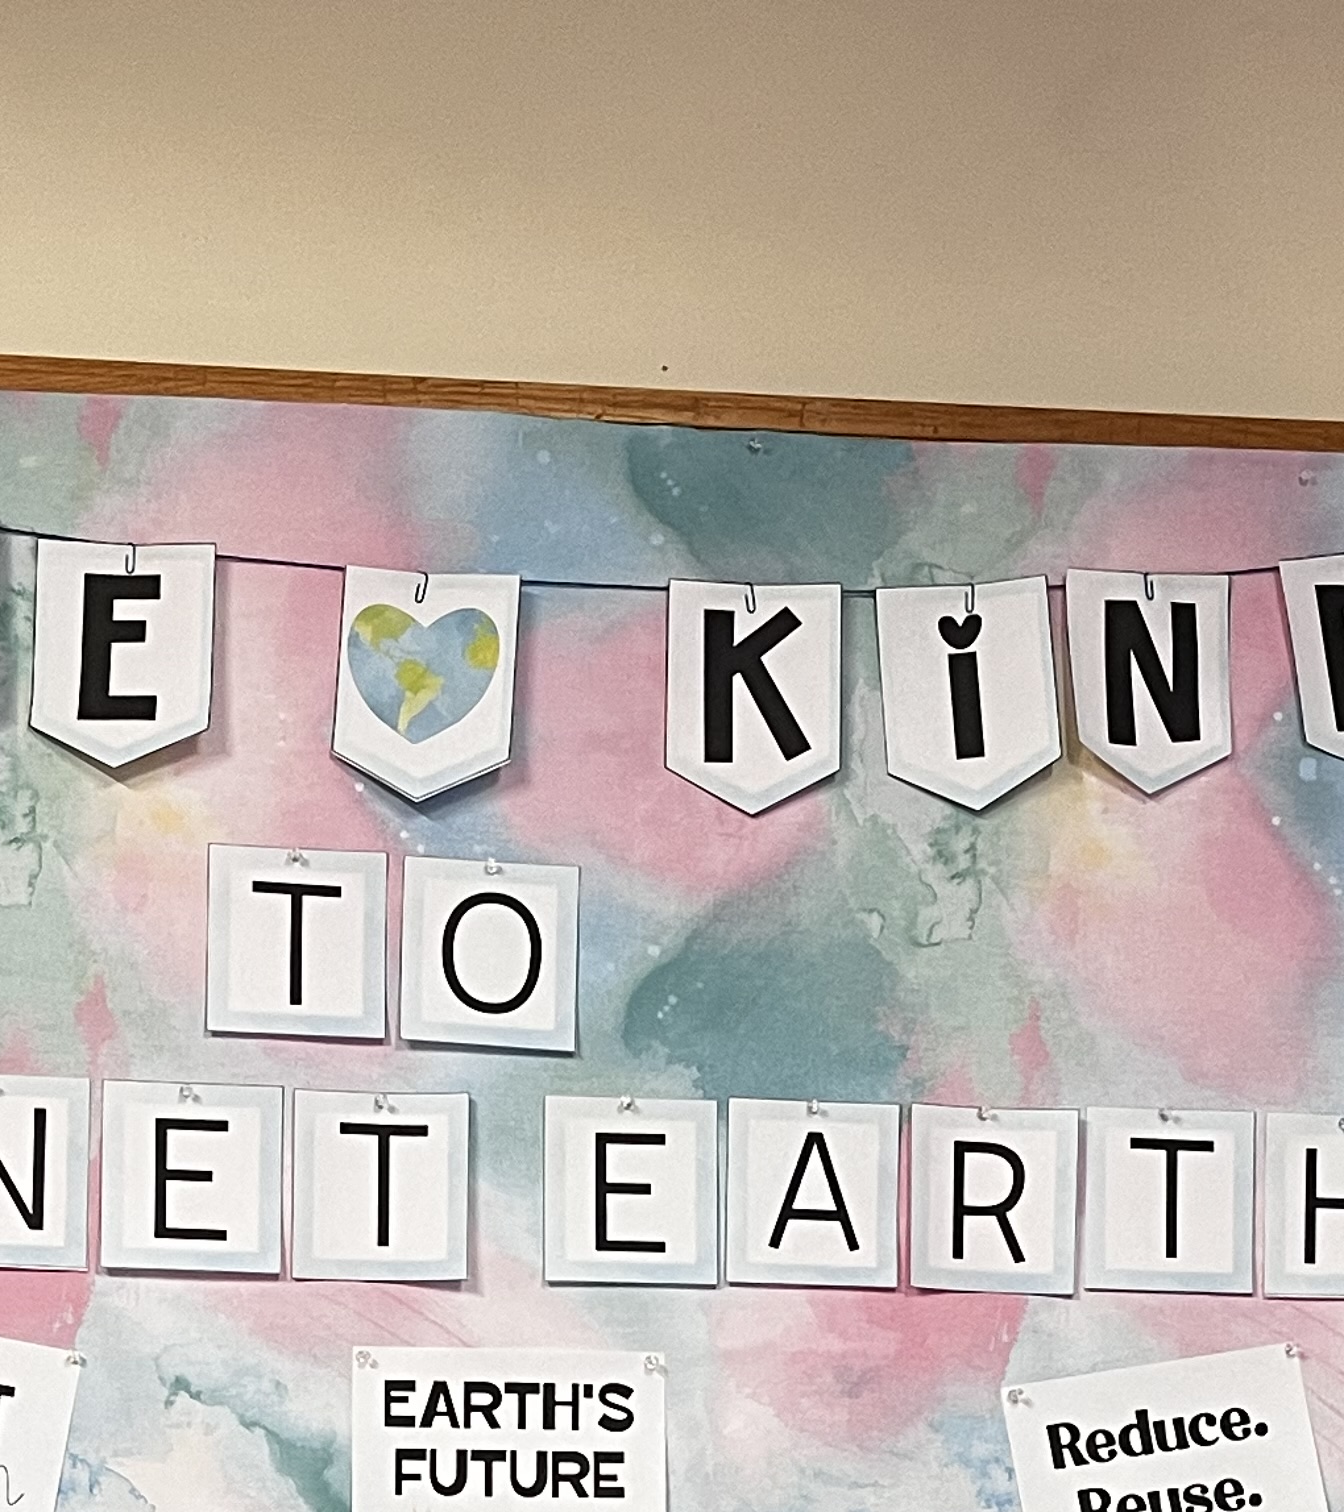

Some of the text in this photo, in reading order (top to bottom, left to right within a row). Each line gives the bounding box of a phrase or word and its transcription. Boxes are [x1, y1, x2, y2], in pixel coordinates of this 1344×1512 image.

[252, 881, 542, 1014] TO
[383, 1379, 635, 1432] EARTH'S
[1045, 1406, 1270, 1470] Reduce.
[394, 1449, 626, 1499] FUTURE
